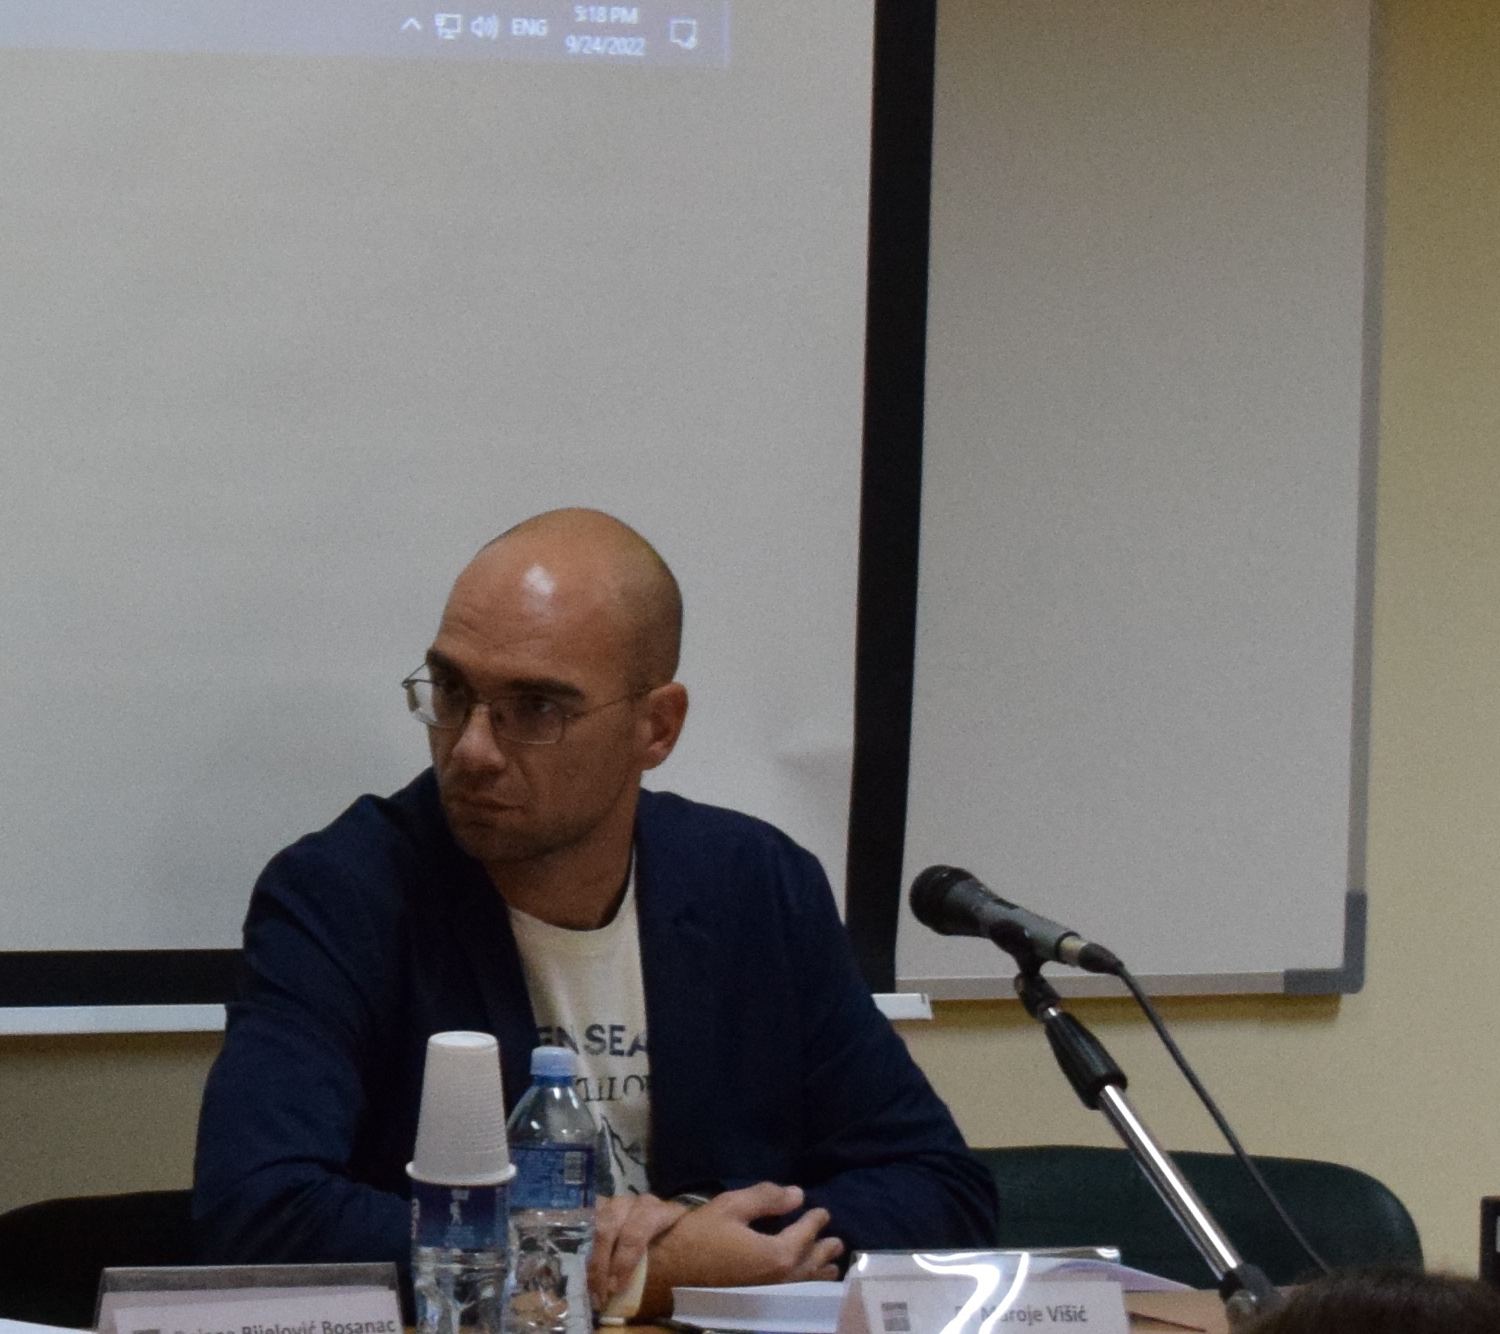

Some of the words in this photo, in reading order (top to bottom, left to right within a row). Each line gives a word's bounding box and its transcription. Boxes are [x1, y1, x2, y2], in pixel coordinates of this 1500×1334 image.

[511, 18, 548, 37] ENG
[565, 34, 646, 56] 9/24/2022
[1046, 1304, 1088, 1323] Višić
